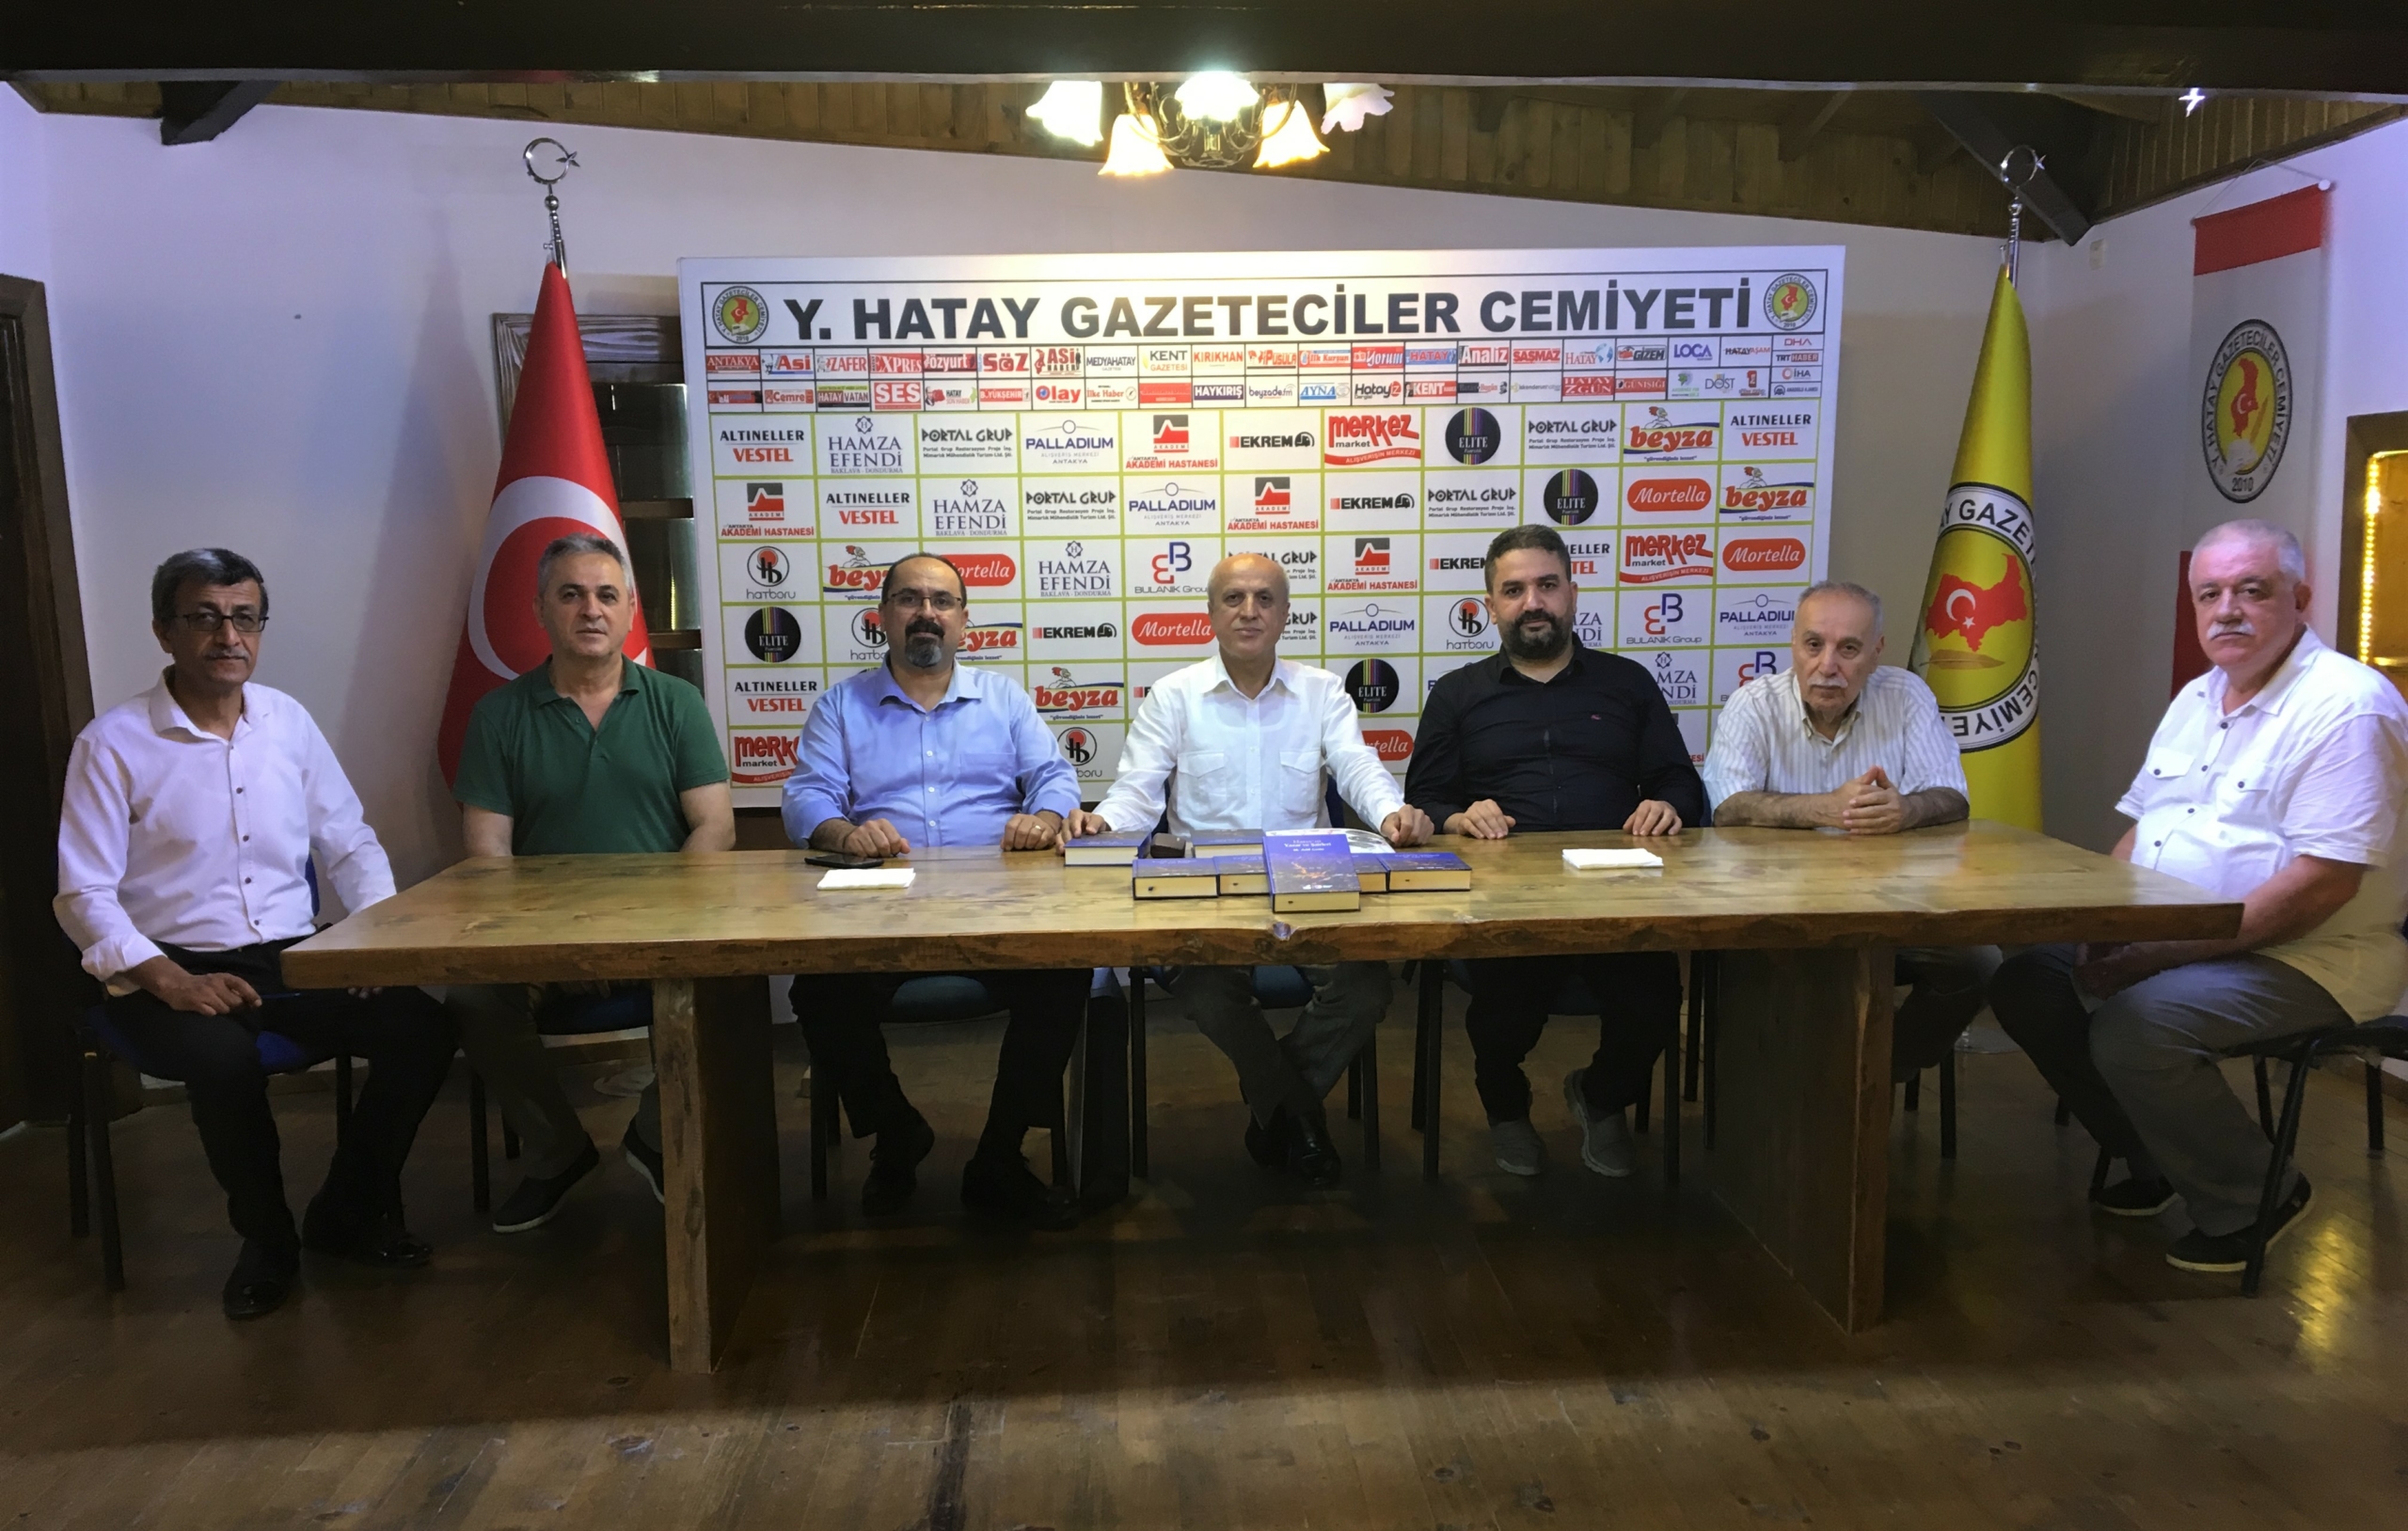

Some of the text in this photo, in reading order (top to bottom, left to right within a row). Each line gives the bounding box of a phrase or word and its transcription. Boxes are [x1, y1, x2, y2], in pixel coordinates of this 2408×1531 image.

[784, 277, 1751, 339] Y. HATAY GAZETECİLER CEMİYETİ
[1783, 338, 1813, 346] DHA
[1149, 350, 1188, 361] KENT
[1194, 351, 1244, 363] KIRIKHAN
[1410, 351, 1449, 362] HATAY
[1462, 347, 1509, 364] Analiz
[1565, 351, 1597, 365] HATAY
[1633, 347, 1665, 361] GİZEM
[1674, 344, 1713, 358] LOCA
[1792, 353, 1818, 362] HABER
[708, 357, 759, 368] ANTAKYA
[777, 355, 812, 371] Asi
[832, 356, 867, 372] ZAFER
[876, 354, 923, 373] EXPRES
[929, 354, 968, 372] özyurt
[1086, 356, 1136, 367] MEDYAHATAY
[1367, 351, 1403, 367] Yorum
[1794, 367, 1812, 378] İHA
[773, 391, 806, 402] Cemre
[817, 391, 869, 402] HATAY VATAN
[876, 383, 921, 403] SES
[1036, 385, 1082, 403] Olay
[1194, 386, 1244, 400] HAYKIRIŞ
[1301, 385, 1337, 397] AYNA
[1413, 383, 1445, 396] KENT
[2205, 329, 2289, 467] HATAY GAZETECİLER CEMİYETİ
[1528, 418, 1617, 434] PORTAL GRUP
[1730, 414, 1812, 427] ALTINELLER
[720, 430, 805, 442] ALTINELLER
[922, 428, 1013, 442] PORTAL GRUP
[1240, 435, 1293, 449] EKREM
[1630, 426, 1714, 453] beyza
[1741, 432, 1798, 447] VESTEL
[828, 435, 903, 450] HAMZA
[1025, 437, 1114, 450] PALLADIUM
[1335, 439, 1370, 449] market
[1458, 436, 1489, 449] ELITE
[733, 448, 794, 463] VESTEL
[830, 450, 903, 468] EFENDİ
[1126, 458, 1218, 469] AKADEMİ HASTANESİ
[2231, 477, 2254, 493] 2010
[826, 493, 911, 505] ALTINELLER
[1025, 490, 1117, 506] PORTAL GRUP
[1427, 488, 1516, 503] PORTAL GRUP
[1632, 484, 1706, 504] Mortella
[1725, 485, 1808, 512] beyza
[933, 498, 1006, 513] HAMZA
[1128, 499, 1216, 513] PALLADIUM
[1340, 497, 1394, 510] EKREM
[1557, 497, 1586, 509] ELITE
[839, 509, 899, 525] VESTEL
[934, 514, 1007, 530] EFENDİ
[721, 526, 815, 537] AKADEMİ HASTANESİ
[1227, 519, 1319, 530] AKADEMİ HASTANESİ
[1281, 551, 1318, 564] GRUP
[1728, 545, 1800, 563] Mortella
[1038, 560, 1112, 575] HAMZA
[1040, 576, 1112, 592] EFENDİ
[1134, 585, 1180, 595] BULANIK
[1327, 579, 1418, 591] AKADEMİ HASTANESİ
[1042, 626, 1096, 639] EKREM
[1138, 620, 1212, 639] Mortella
[1329, 620, 1416, 633] PALLADIUM
[759, 635, 789, 647] ELITE
[1625, 636, 1703, 645] BULANIK Group
[735, 681, 817, 693] ALTINELLER
[1357, 686, 1387, 698] ELITE
[747, 698, 807, 712] VESTEL
[1035, 685, 1119, 711] beyza
